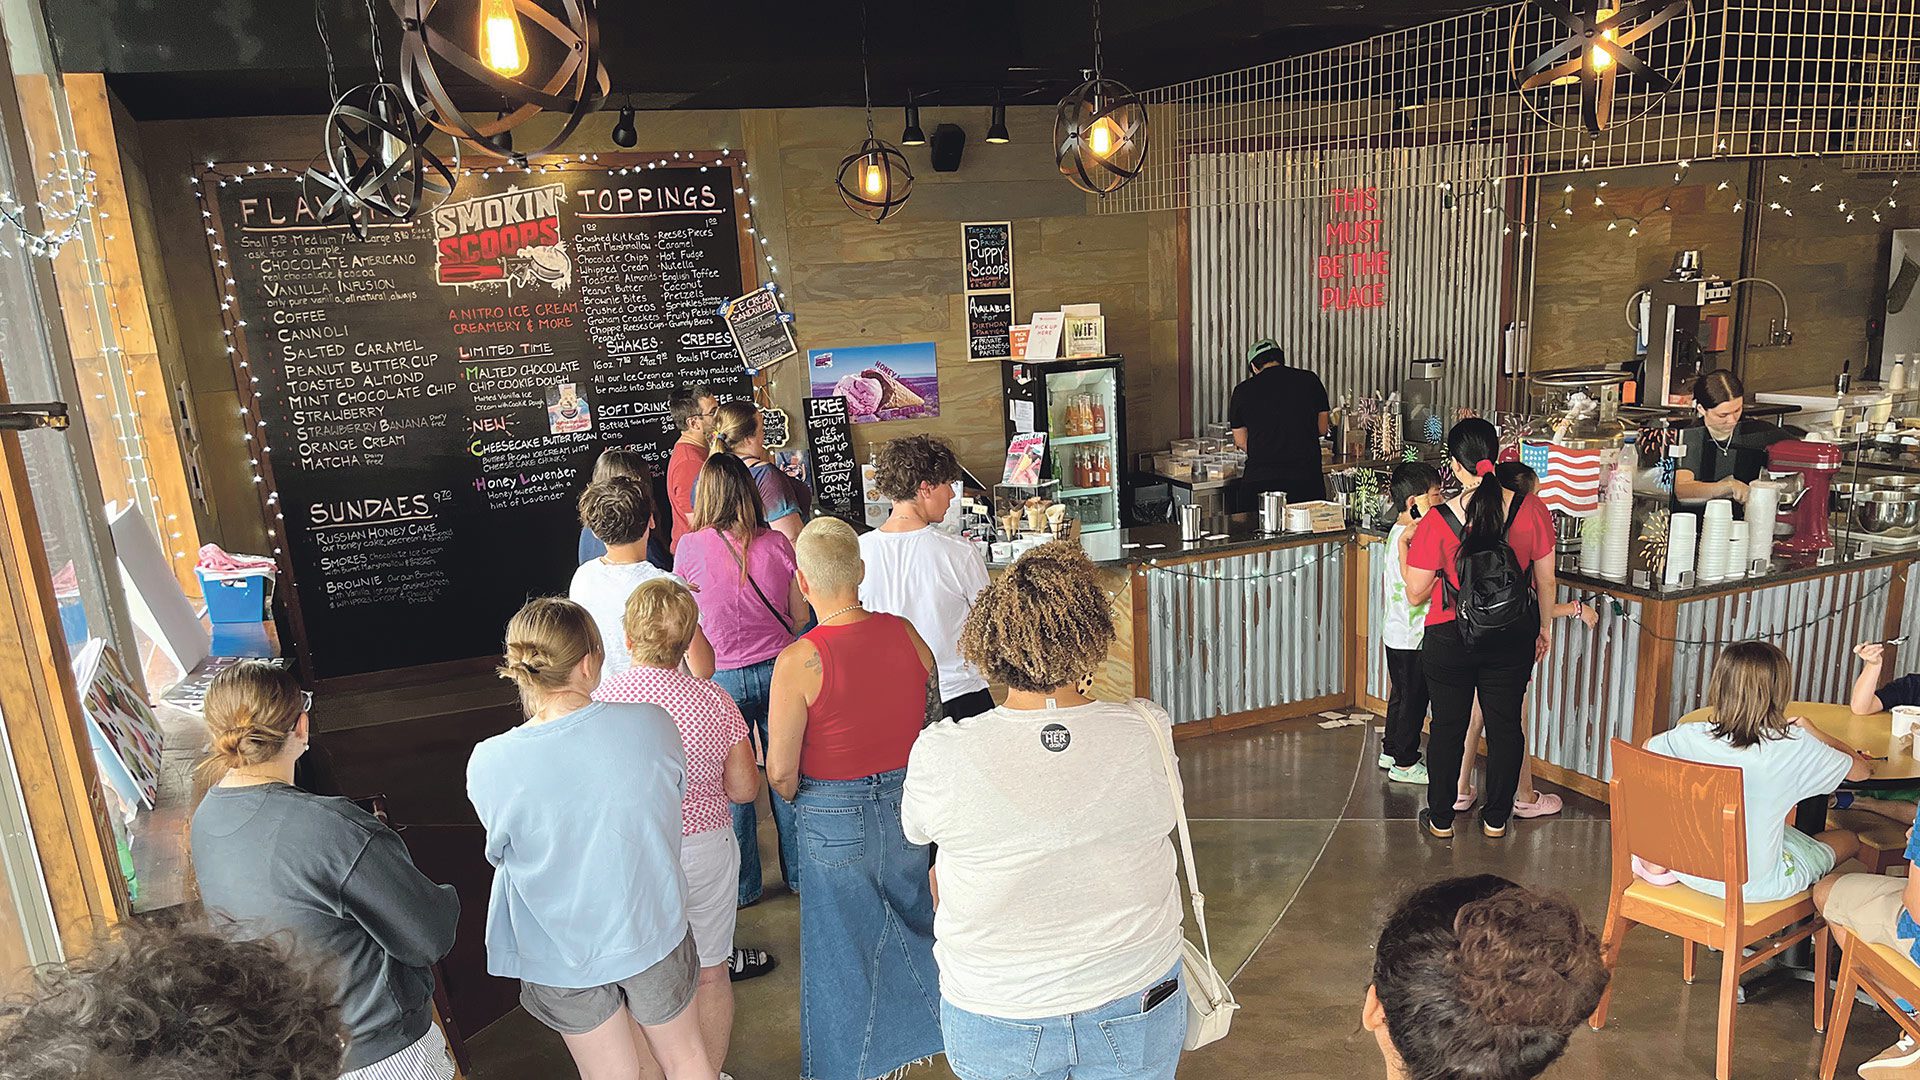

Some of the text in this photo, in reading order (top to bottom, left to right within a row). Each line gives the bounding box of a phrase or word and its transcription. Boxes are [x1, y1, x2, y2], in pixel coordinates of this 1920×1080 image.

[577, 185, 716, 213] TOPPINGS
[1331, 187, 1377, 213] THIS
[575, 234, 611, 243] Crushed
[1326, 219, 1383, 246] MUST
[240, 234, 390, 248] Small Medium Large
[439, 216, 558, 265] SCOOPS
[576, 241, 651, 253] Burnt Marshmallow
[658, 238, 694, 250] Caramel
[248, 245, 342, 259] ask for sample
[577, 252, 649, 264] Chocolate Chips
[659, 249, 705, 261] Hot Fudge
[260, 253, 417, 273] CHOCOLATE AMERICANO
[579, 263, 649, 276] Whipped Cream
[660, 260, 695, 271] Nutella
[1318, 251, 1390, 279] BE THE
[284, 269, 376, 281] chocolate cocoa
[580, 272, 657, 285] Toasted Almonds
[662, 267, 720, 283] English Toffee
[263, 279, 395, 298] VANILLA INFUSION
[581, 283, 644, 296] Peanut Butter
[663, 280, 703, 291] Coconut
[583, 293, 648, 305] Brownie Bites
[664, 289, 704, 301] Pretzels
[1322, 282, 1386, 312] PLACE
[449, 302, 578, 321] A NITRO ICE CREAM
[585, 302, 656, 315] Crushed Oreos
[665, 299, 702, 312] Sprinkles
[273, 310, 326, 325] COFFEE
[587, 312, 660, 326] Graham Crackers
[666, 310, 690, 321] Fruity
[453, 316, 573, 335] CREAMERY MORE
[972, 321, 1008, 329] BIRTHDAY
[1072, 322, 1098, 337] WiFi
[278, 326, 349, 343] CANNOLI
[592, 332, 626, 344] Peanuts
[680, 331, 733, 346] CREPES
[283, 339, 424, 362] SALTED CARAMEL
[459, 342, 553, 359] LIMITED TIME
[606, 336, 658, 354] SHAKES
[676, 349, 732, 363] Bowls Cones
[285, 353, 438, 379] PEANUT BUTTER CUP
[465, 360, 580, 380] MALTED CHOCOLATE
[680, 364, 746, 378] Freshly made with
[874, 360, 898, 379] HONEY
[286, 371, 424, 395] TOASTED ALMOND
[469, 374, 570, 393] CHIP COOKIE DOUGH
[594, 374, 605, 383] All
[623, 372, 637, 381] Ice
[637, 370, 661, 380] Cream
[713, 375, 739, 386] recipe
[595, 380, 675, 394] be made into Shakes
[289, 382, 457, 410] MINT CHOCOLATE CHIP
[597, 403, 630, 417] SOFT
[810, 397, 845, 416] FREE
[293, 406, 385, 426] STRAWBERRY
[808, 415, 847, 430] MEDIUM
[296, 418, 429, 442] STRAWBERRY BANANA
[472, 416, 506, 433] NEW
[599, 420, 630, 431] Bottled
[821, 427, 837, 436] ICE
[602, 432, 623, 440] Cans
[814, 432, 846, 445] CREAM
[299, 434, 406, 457] ORANGE CREAM
[471, 432, 598, 457] CHEESECAKE BUTTER PECAN
[816, 442, 849, 454] WITH UP
[301, 455, 360, 471] MATCHA
[483, 454, 567, 473] CHEESE CAKE CHUNKS
[819, 452, 843, 463] TO 3
[819, 458, 855, 472] TOPPINGS
[475, 467, 577, 492] Honey Lavender
[818, 472, 851, 484] TODAY
[487, 481, 564, 500] Honey with
[824, 481, 852, 494] ONLY
[490, 491, 565, 510] hint Lavender
[310, 494, 430, 524] SUNDAES
[316, 523, 437, 546] RUSSIAN HONEY CAKE
[320, 553, 368, 571] SMORES
[325, 575, 382, 594] BROWNIE
[1045, 733, 1067, 744] HER
